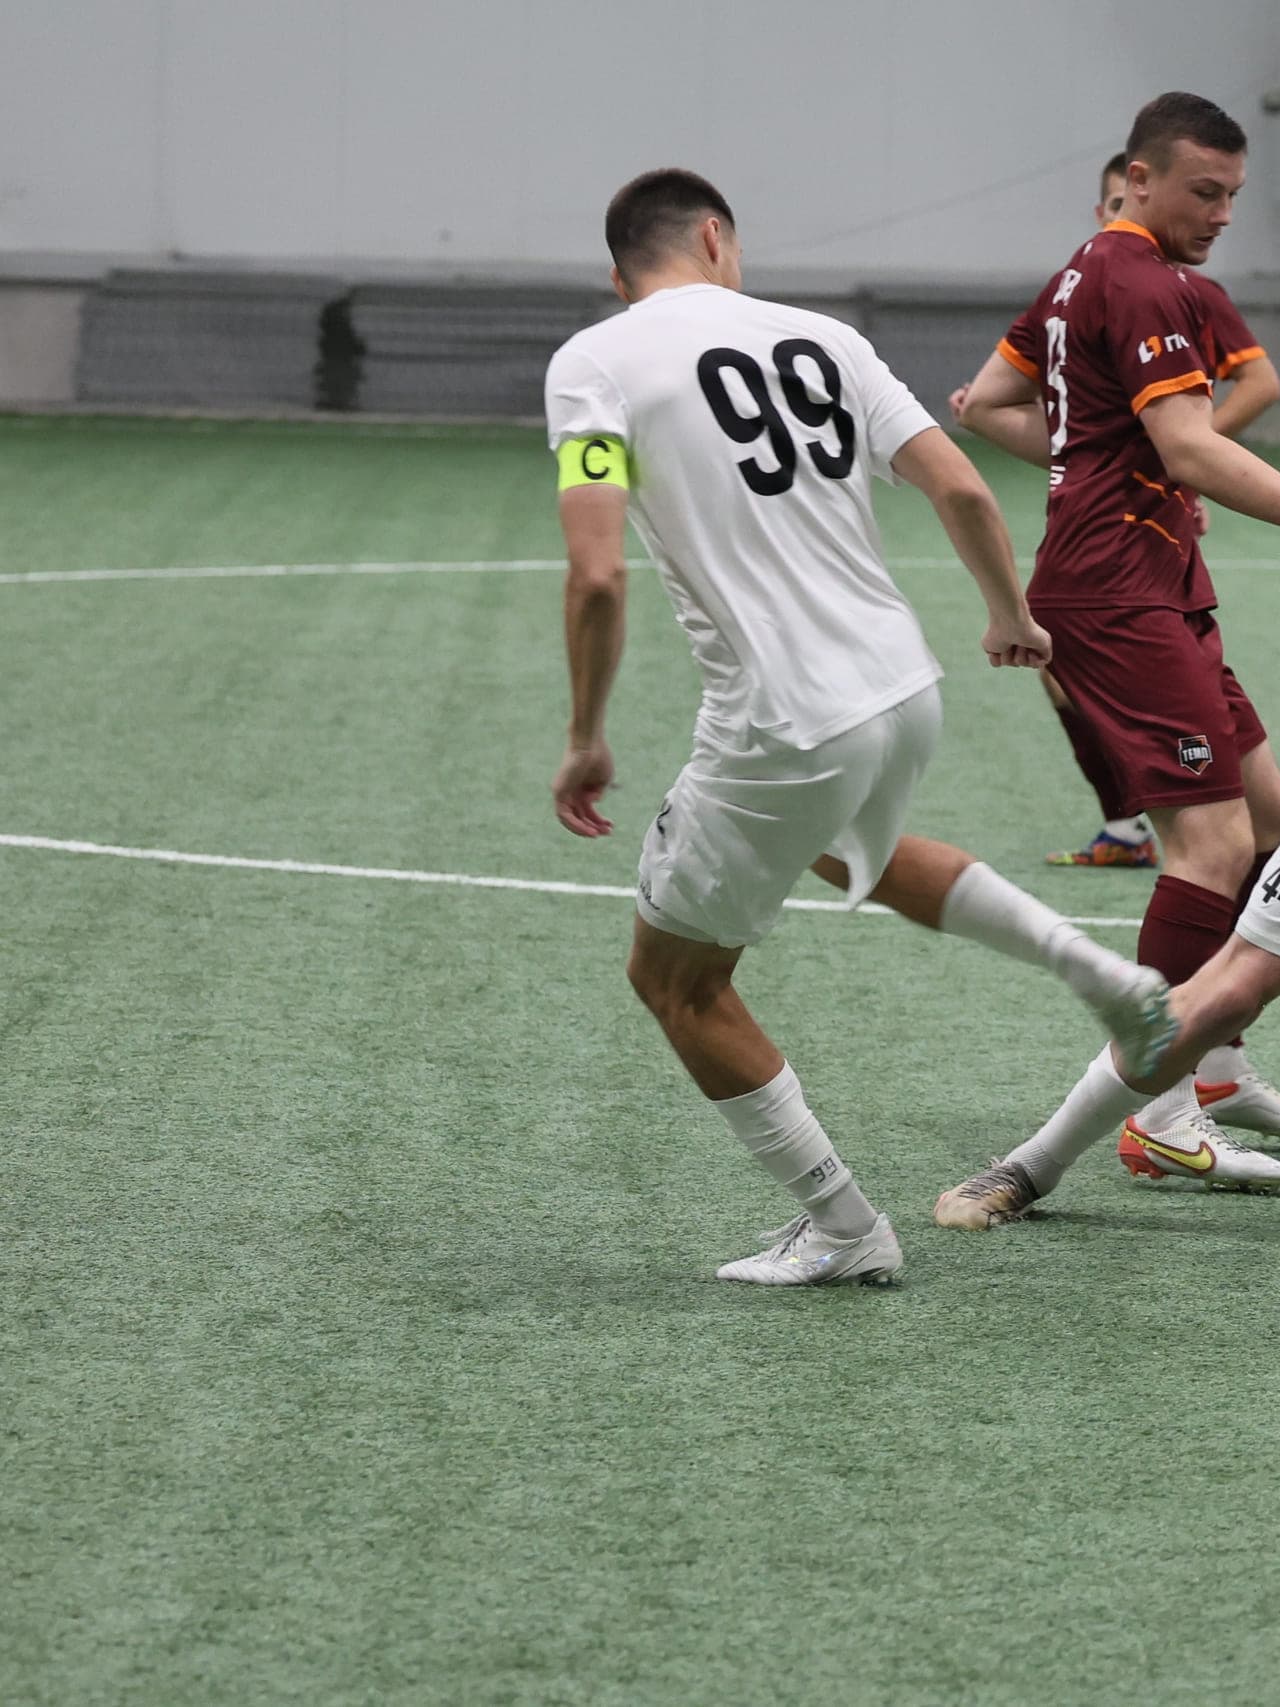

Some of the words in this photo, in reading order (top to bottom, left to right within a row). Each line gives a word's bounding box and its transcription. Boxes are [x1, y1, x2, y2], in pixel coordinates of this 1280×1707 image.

[697, 337, 856, 497] 99
[581, 439, 610, 480] C
[810, 1156, 838, 1184] 99
